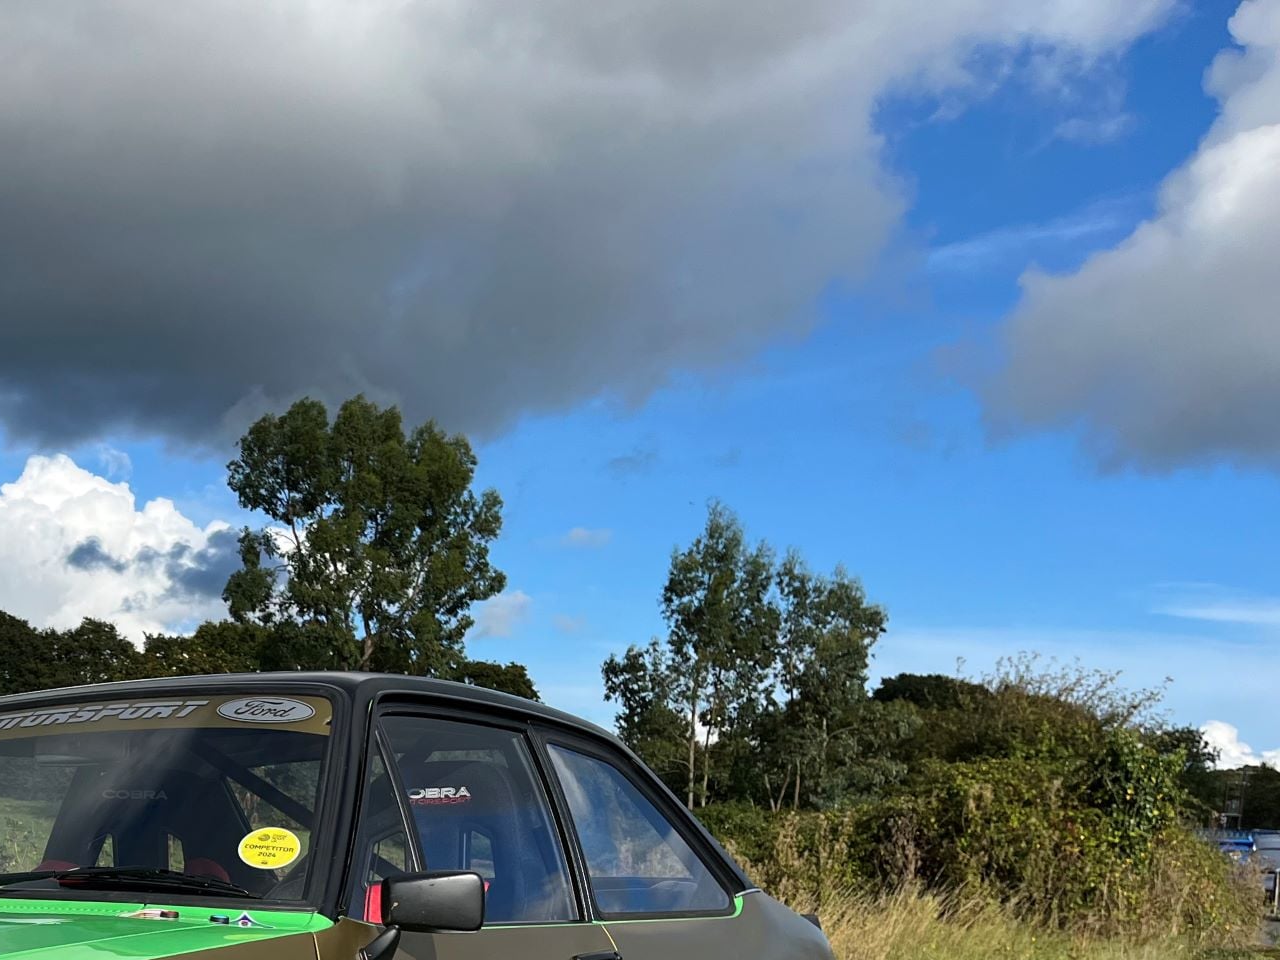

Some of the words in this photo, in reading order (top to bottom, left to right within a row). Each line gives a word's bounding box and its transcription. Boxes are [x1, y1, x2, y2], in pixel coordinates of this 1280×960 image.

[234, 700, 296, 718] Ford
[102, 788, 168, 801] COBRA
[407, 786, 471, 799] OBRA
[244, 843, 295, 853] COMPETITOR
